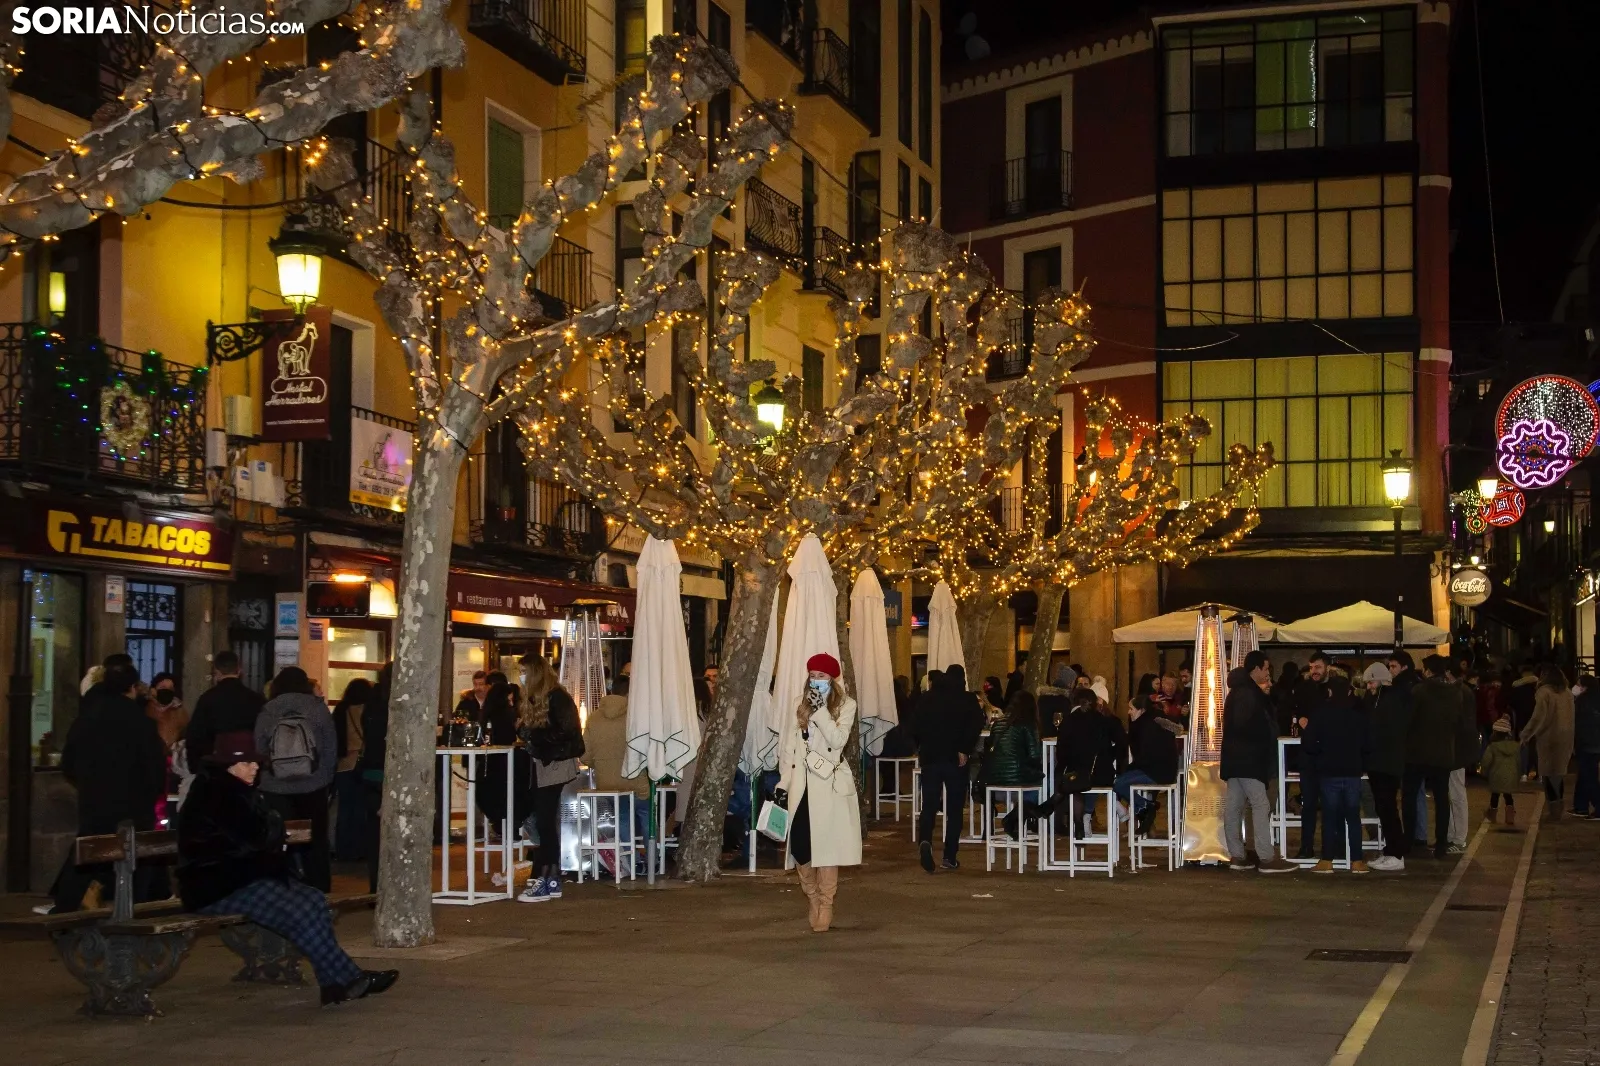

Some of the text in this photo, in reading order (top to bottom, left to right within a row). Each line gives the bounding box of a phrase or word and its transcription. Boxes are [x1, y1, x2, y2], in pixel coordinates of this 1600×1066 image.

[90, 516, 211, 556] TABACOS
[1451, 577, 1487, 593] Coca-Cola
[466, 595, 503, 607] restaurante
